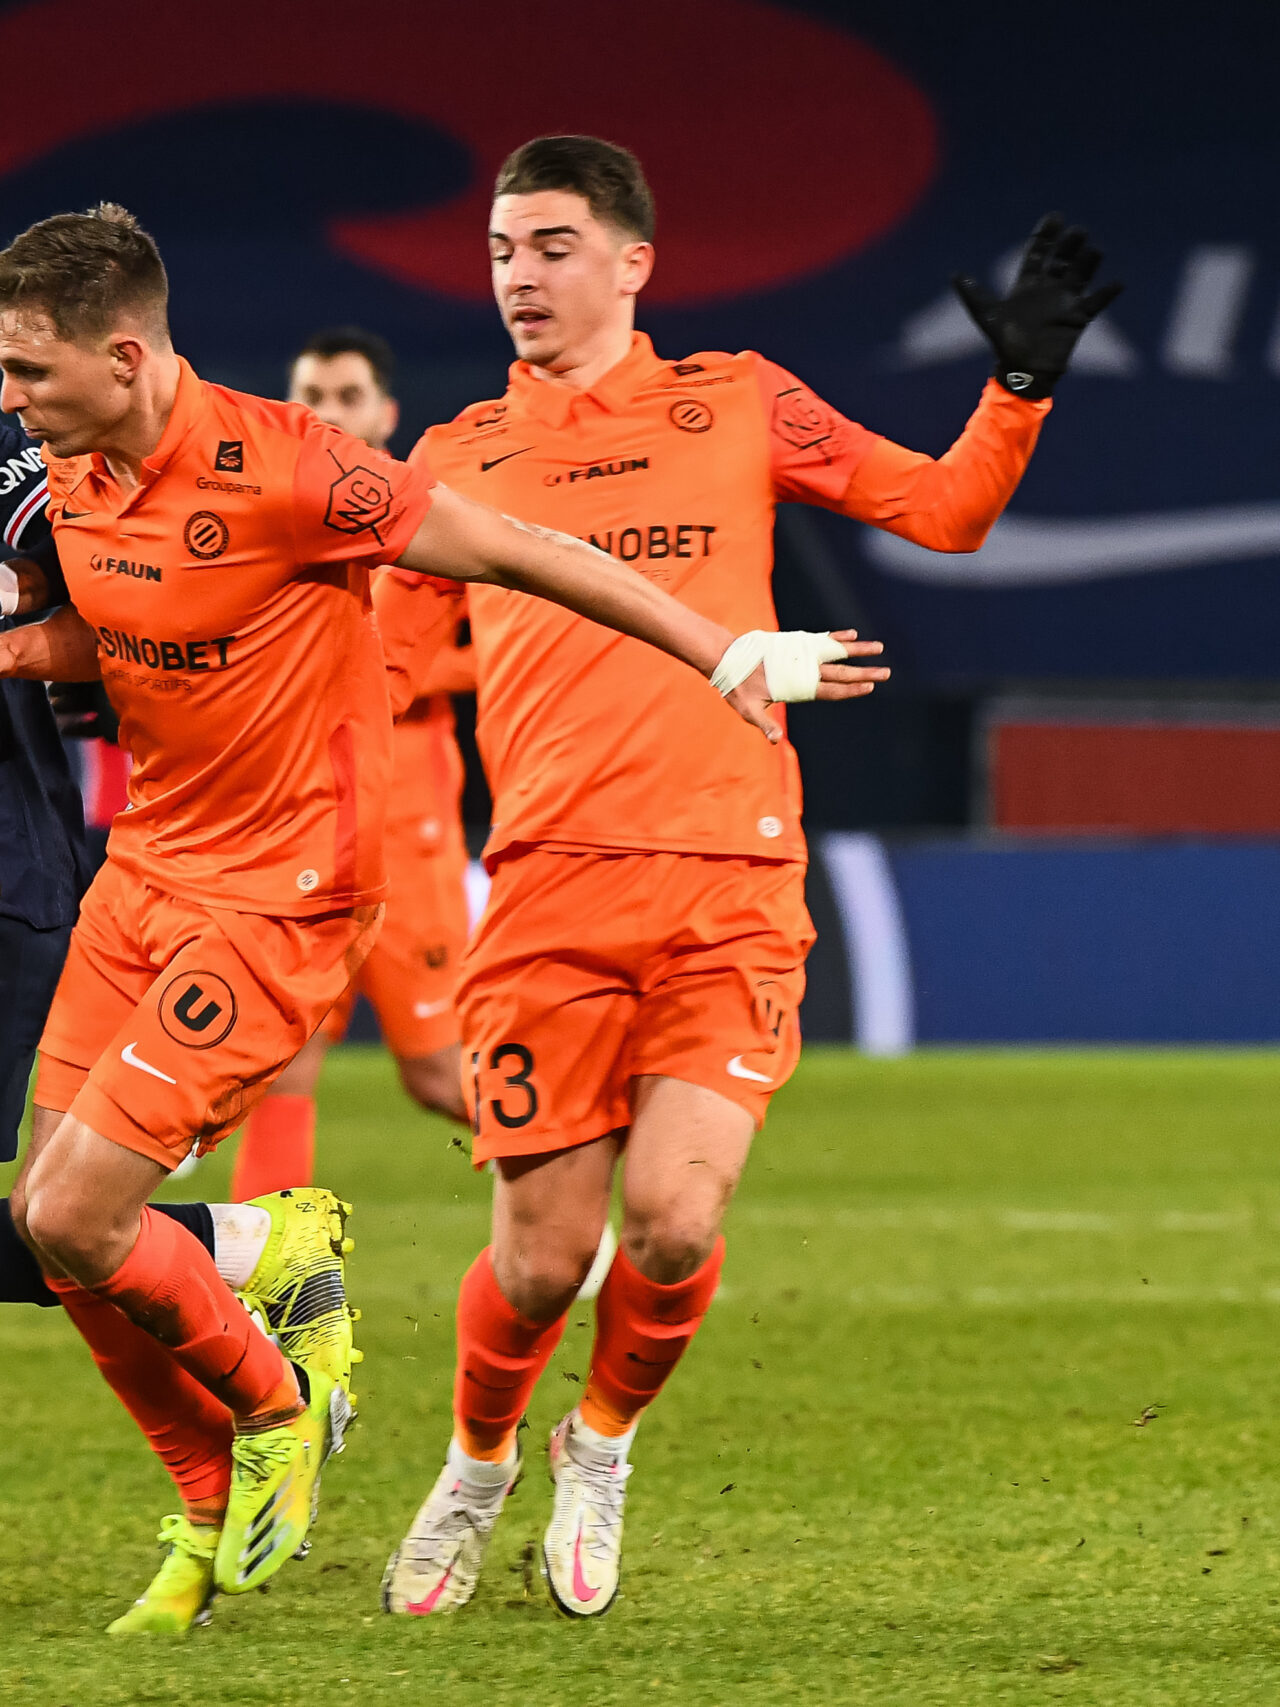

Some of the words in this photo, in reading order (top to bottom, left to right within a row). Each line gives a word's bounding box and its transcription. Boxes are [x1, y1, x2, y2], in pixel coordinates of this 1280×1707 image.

[196, 476, 262, 495] Groupama
[568, 456, 650, 483] FAUN
[336, 480, 381, 528] NG
[589, 524, 717, 562] NOBET
[106, 557, 162, 583] FAUN
[96, 626, 236, 671] SINOBET
[173, 983, 222, 1032] U
